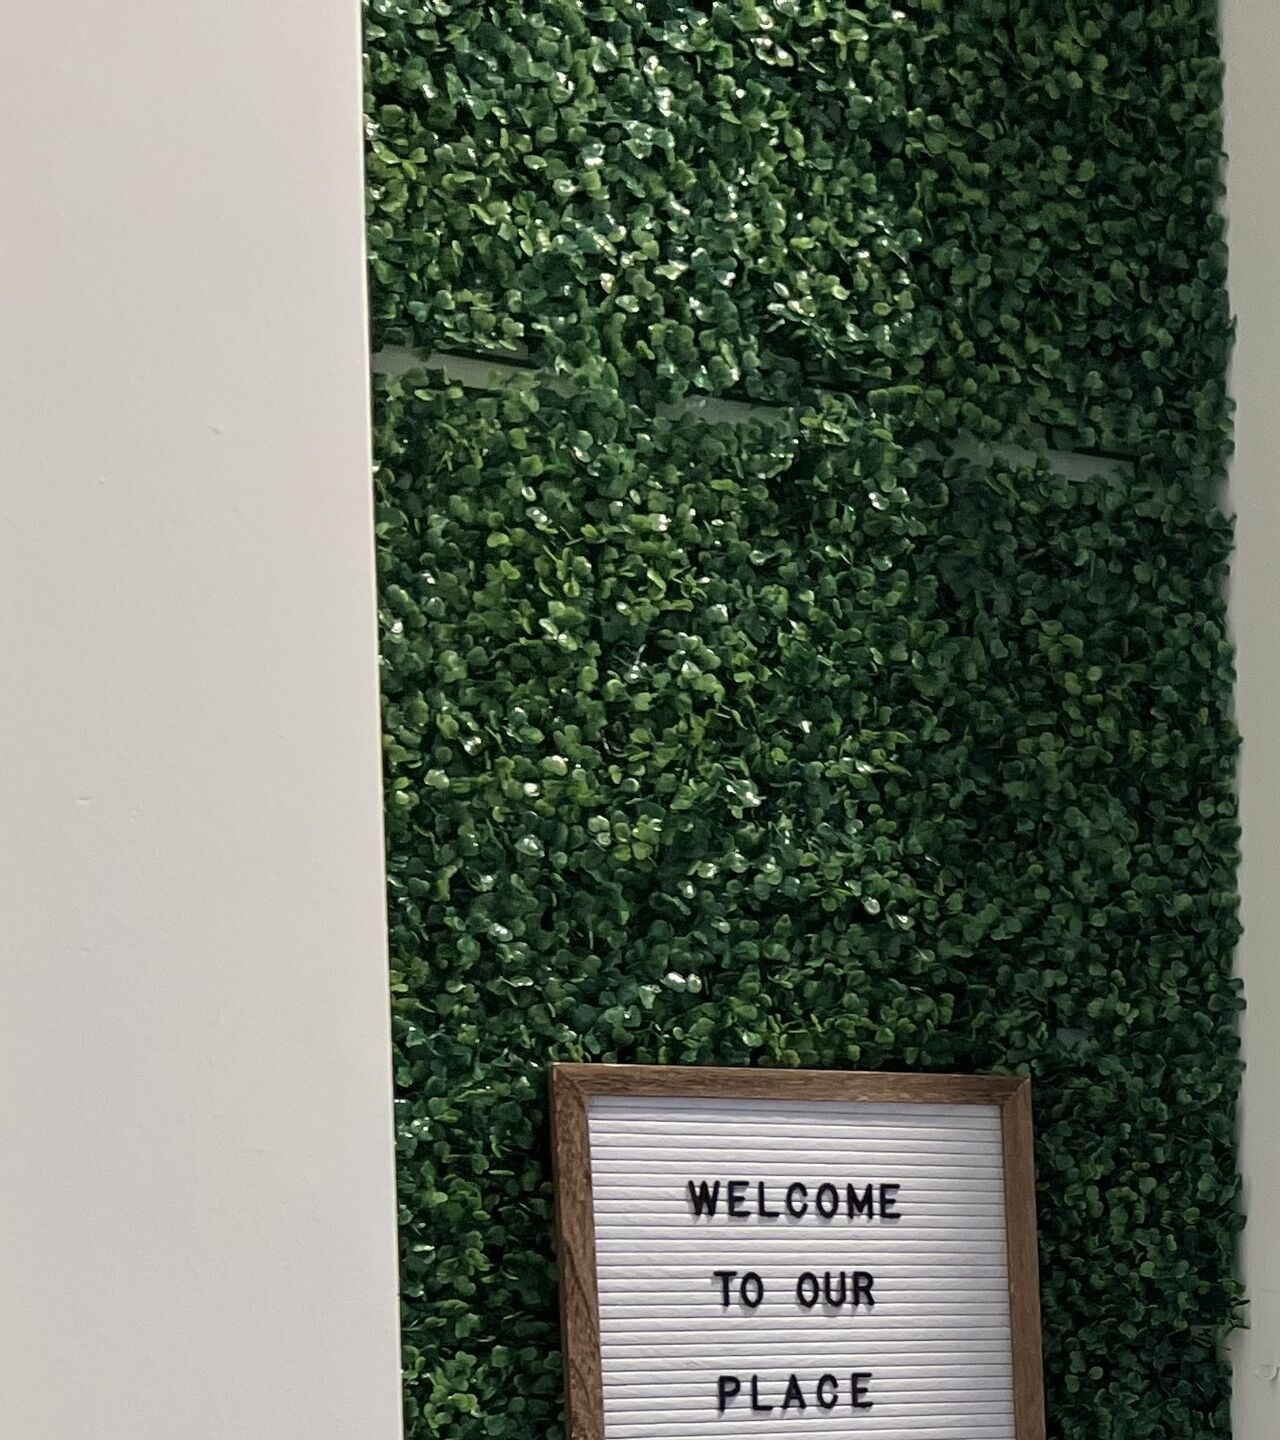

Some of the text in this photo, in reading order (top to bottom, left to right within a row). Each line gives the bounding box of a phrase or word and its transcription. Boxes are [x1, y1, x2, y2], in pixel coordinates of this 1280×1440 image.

[687, 1180, 902, 1219] WELCOME
[713, 1271, 875, 1308] TO OUR
[718, 1372, 874, 1413] PLACE
